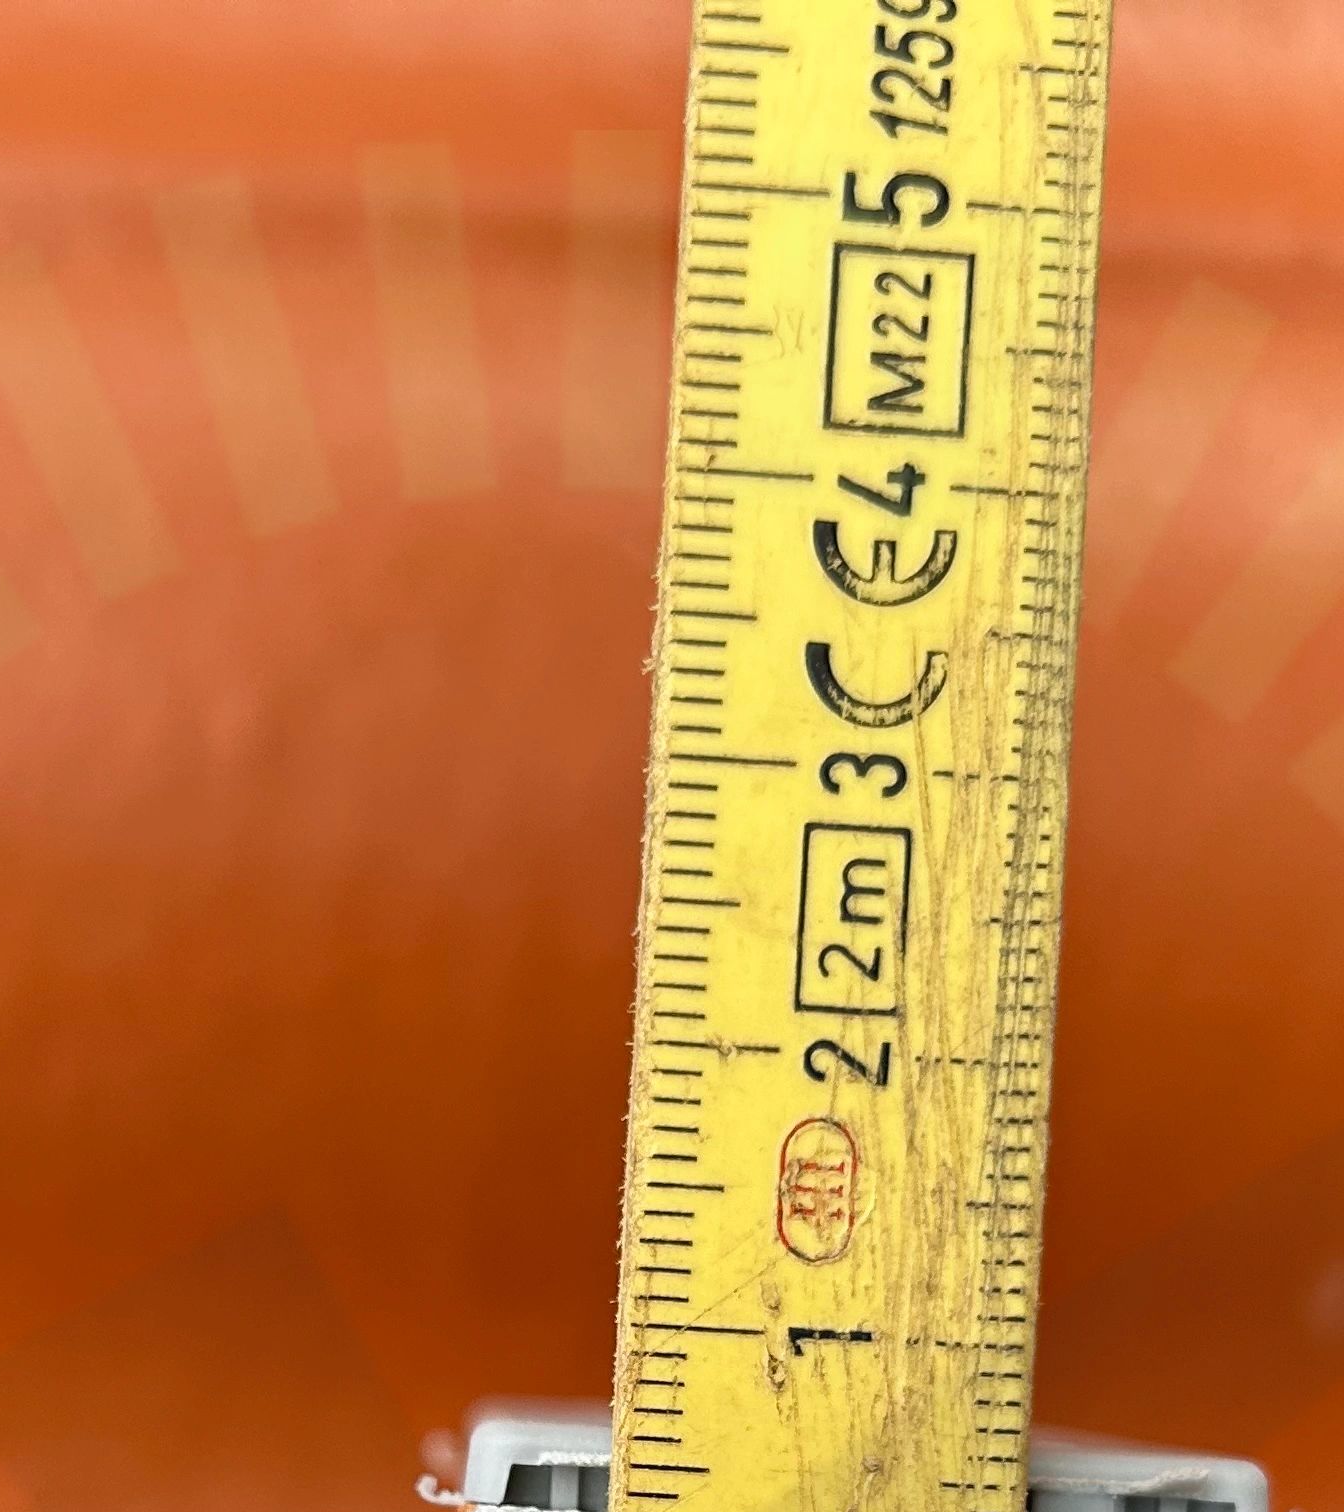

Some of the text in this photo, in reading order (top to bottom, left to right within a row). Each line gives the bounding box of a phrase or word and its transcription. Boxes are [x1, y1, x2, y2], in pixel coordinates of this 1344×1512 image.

[842, 171, 950, 228] 5
[867, 271, 933, 414] M22
[837, 463, 925, 517] 4
[820, 752, 907, 798] 3
[803, 1039, 891, 1086] 2
[788, 1327, 873, 1356] 1
